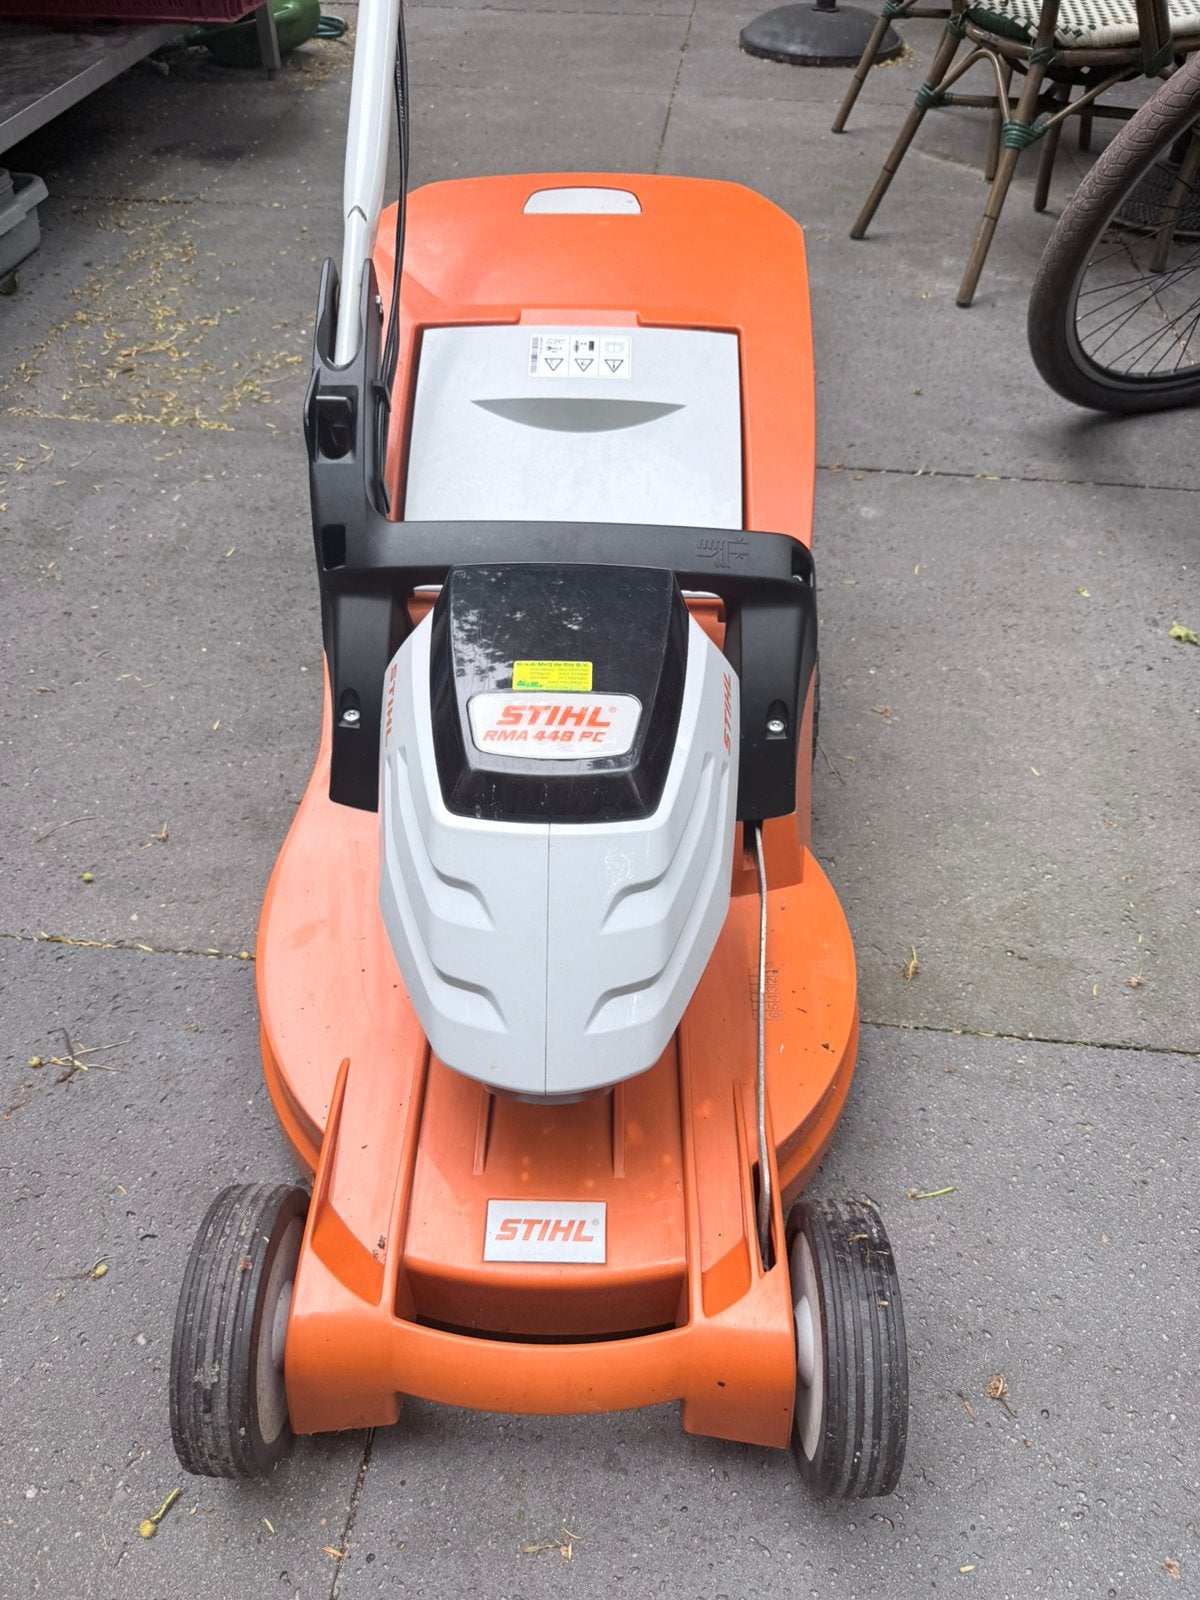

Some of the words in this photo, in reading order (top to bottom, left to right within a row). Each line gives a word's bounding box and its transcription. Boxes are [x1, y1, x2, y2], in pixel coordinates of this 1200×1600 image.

[385, 663, 398, 748] STIHL
[496, 705, 611, 728] STIHL
[723, 672, 732, 756] STIHL
[482, 730, 528, 742] RMA
[532, 731, 574, 742] 448
[578, 731, 606, 743] PC
[495, 1218, 594, 1242] STIHL
